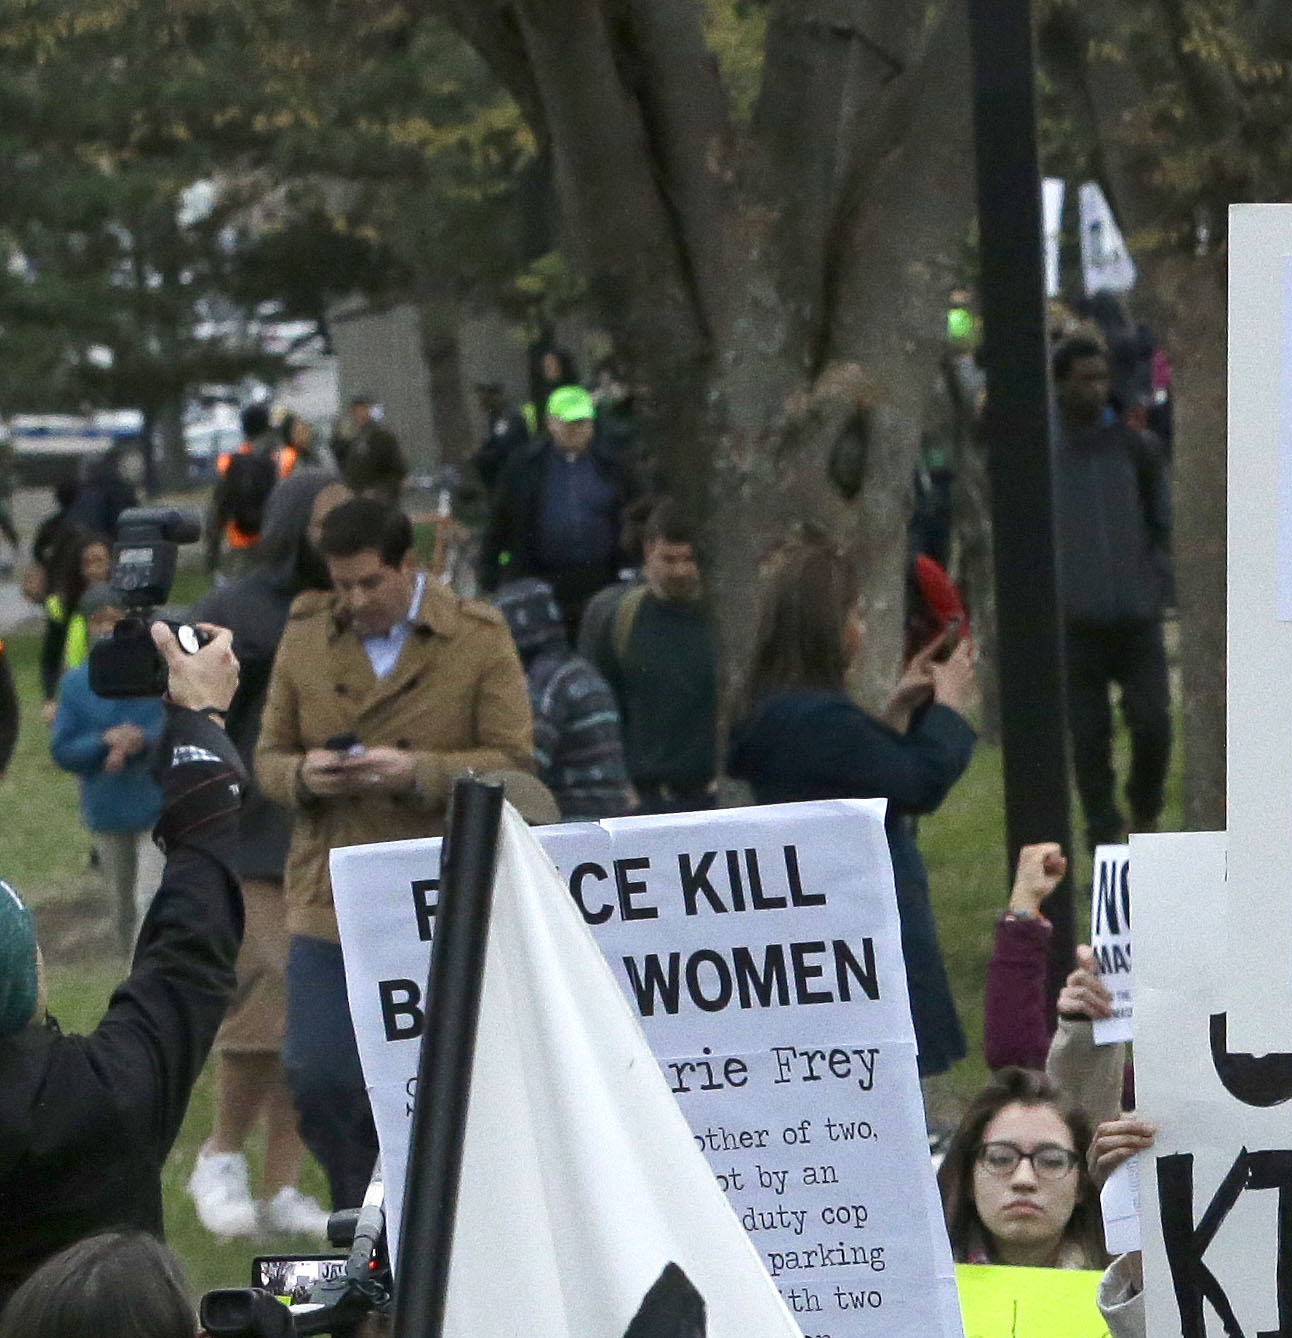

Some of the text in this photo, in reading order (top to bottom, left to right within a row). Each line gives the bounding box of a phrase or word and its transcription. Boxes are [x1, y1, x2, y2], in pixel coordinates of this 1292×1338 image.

[677, 844, 827, 916] KILL
[622, 936, 882, 1019] WOMEN
[773, 1047, 880, 1091] Frey
[782, 1118, 812, 1147] of
[826, 1115, 880, 1143] two,
[757, 1166, 790, 1196] by
[802, 1165, 839, 1187] an
[820, 1203, 869, 1234] cop
[769, 1243, 887, 1276] parking
[833, 1286, 883, 1311] two
